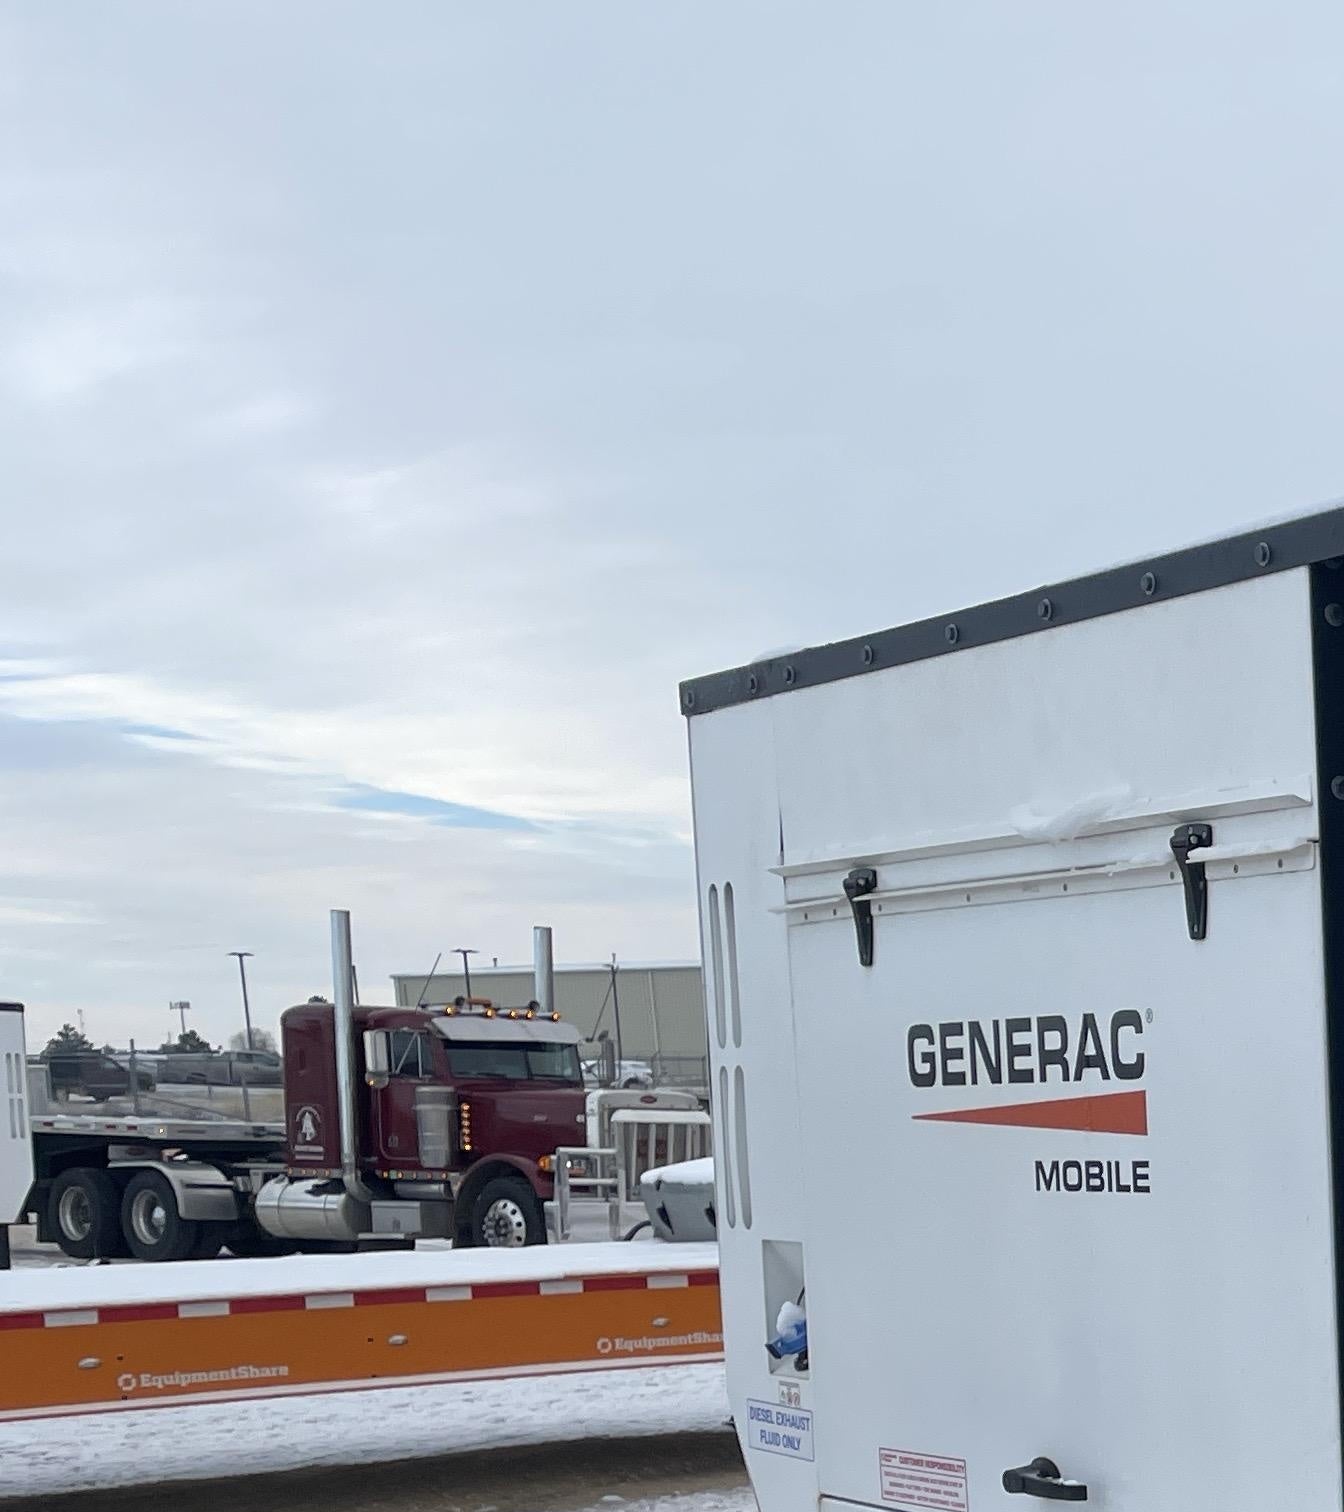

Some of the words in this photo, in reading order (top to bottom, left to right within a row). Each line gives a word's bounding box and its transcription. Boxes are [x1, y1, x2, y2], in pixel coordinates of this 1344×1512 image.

[907, 1009, 1146, 1087] GENERAC
[1034, 1160, 1151, 1193] MOBILE
[614, 1332, 723, 1351] EquipmentSha
[140, 1365, 289, 1388] EquipmentShare
[750, 1406, 775, 1424] DIESEL
[776, 1412, 810, 1432] EXHAUST
[760, 1429, 780, 1446] FLUID
[782, 1434, 801, 1451] ONLY
